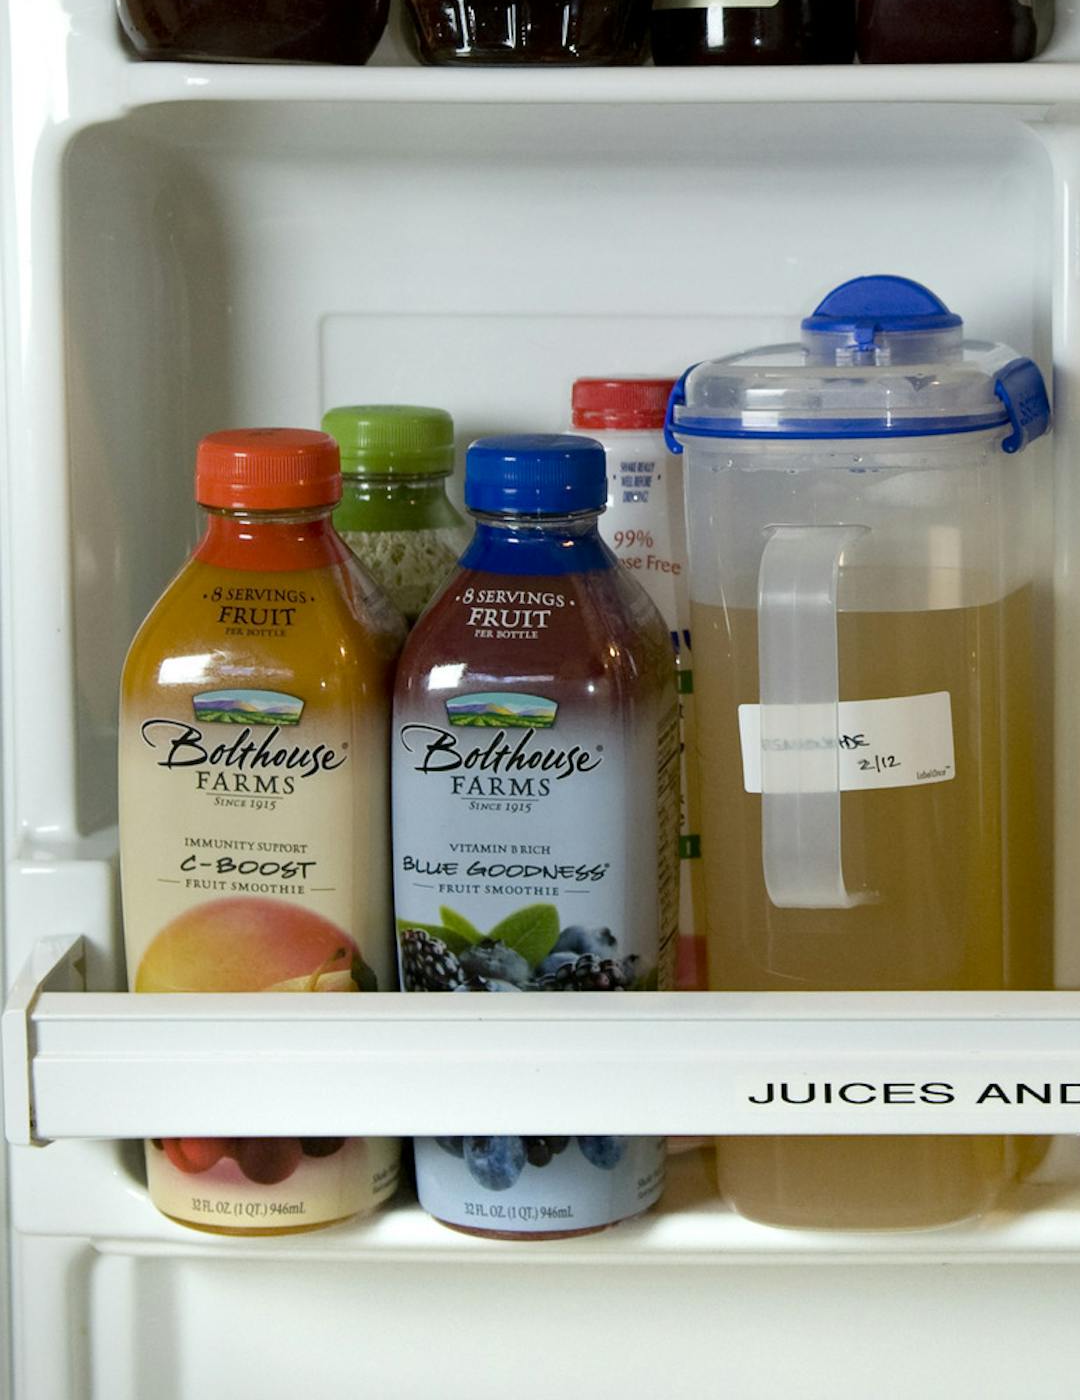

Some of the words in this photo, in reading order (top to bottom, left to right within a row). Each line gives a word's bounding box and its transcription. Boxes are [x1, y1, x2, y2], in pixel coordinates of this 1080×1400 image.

[613, 529, 655, 549] 99%
[646, 555, 683, 576] Free
[211, 586, 223, 603] 8
[225, 587, 307, 604] SERVINGS
[462, 587, 475, 605] 8
[476, 589, 566, 608] SERVINGS
[217, 606, 297, 626] FRUIT
[465, 607, 552, 628] FRUIT
[474, 629, 494, 639] PER
[496, 629, 539, 640] BOTTLE
[141, 719, 347, 778] Bolthouse
[401, 723, 602, 780] Bolthouse
[857, 754, 902, 773] 2/12
[195, 771, 296, 795] FARMS
[451, 775, 552, 798] FARMS
[249, 798, 277, 811] 1915
[505, 801, 533, 814] 1915
[184, 837, 255, 852] IMMUNITY
[257, 841, 309, 855] SUPPORT
[449, 843, 508, 855] VITAMIN
[520, 844, 552, 856] RICH
[180, 854, 317, 880] C-BOOST
[402, 855, 459, 876] BLUE
[466, 860, 607, 883] GOODNESS
[185, 878, 227, 891] FRUIT
[230, 881, 306, 895] SMOOTHIE
[438, 883, 481, 895] FRUIT
[484, 884, 560, 897] SMOOTHIE
[748, 1082, 956, 1106] JUICES
[191, 1198, 201, 1212] 32
[269, 1201, 307, 1216] 946mL
[464, 1202, 475, 1216] 32
[540, 1205, 575, 1219] 946mL
